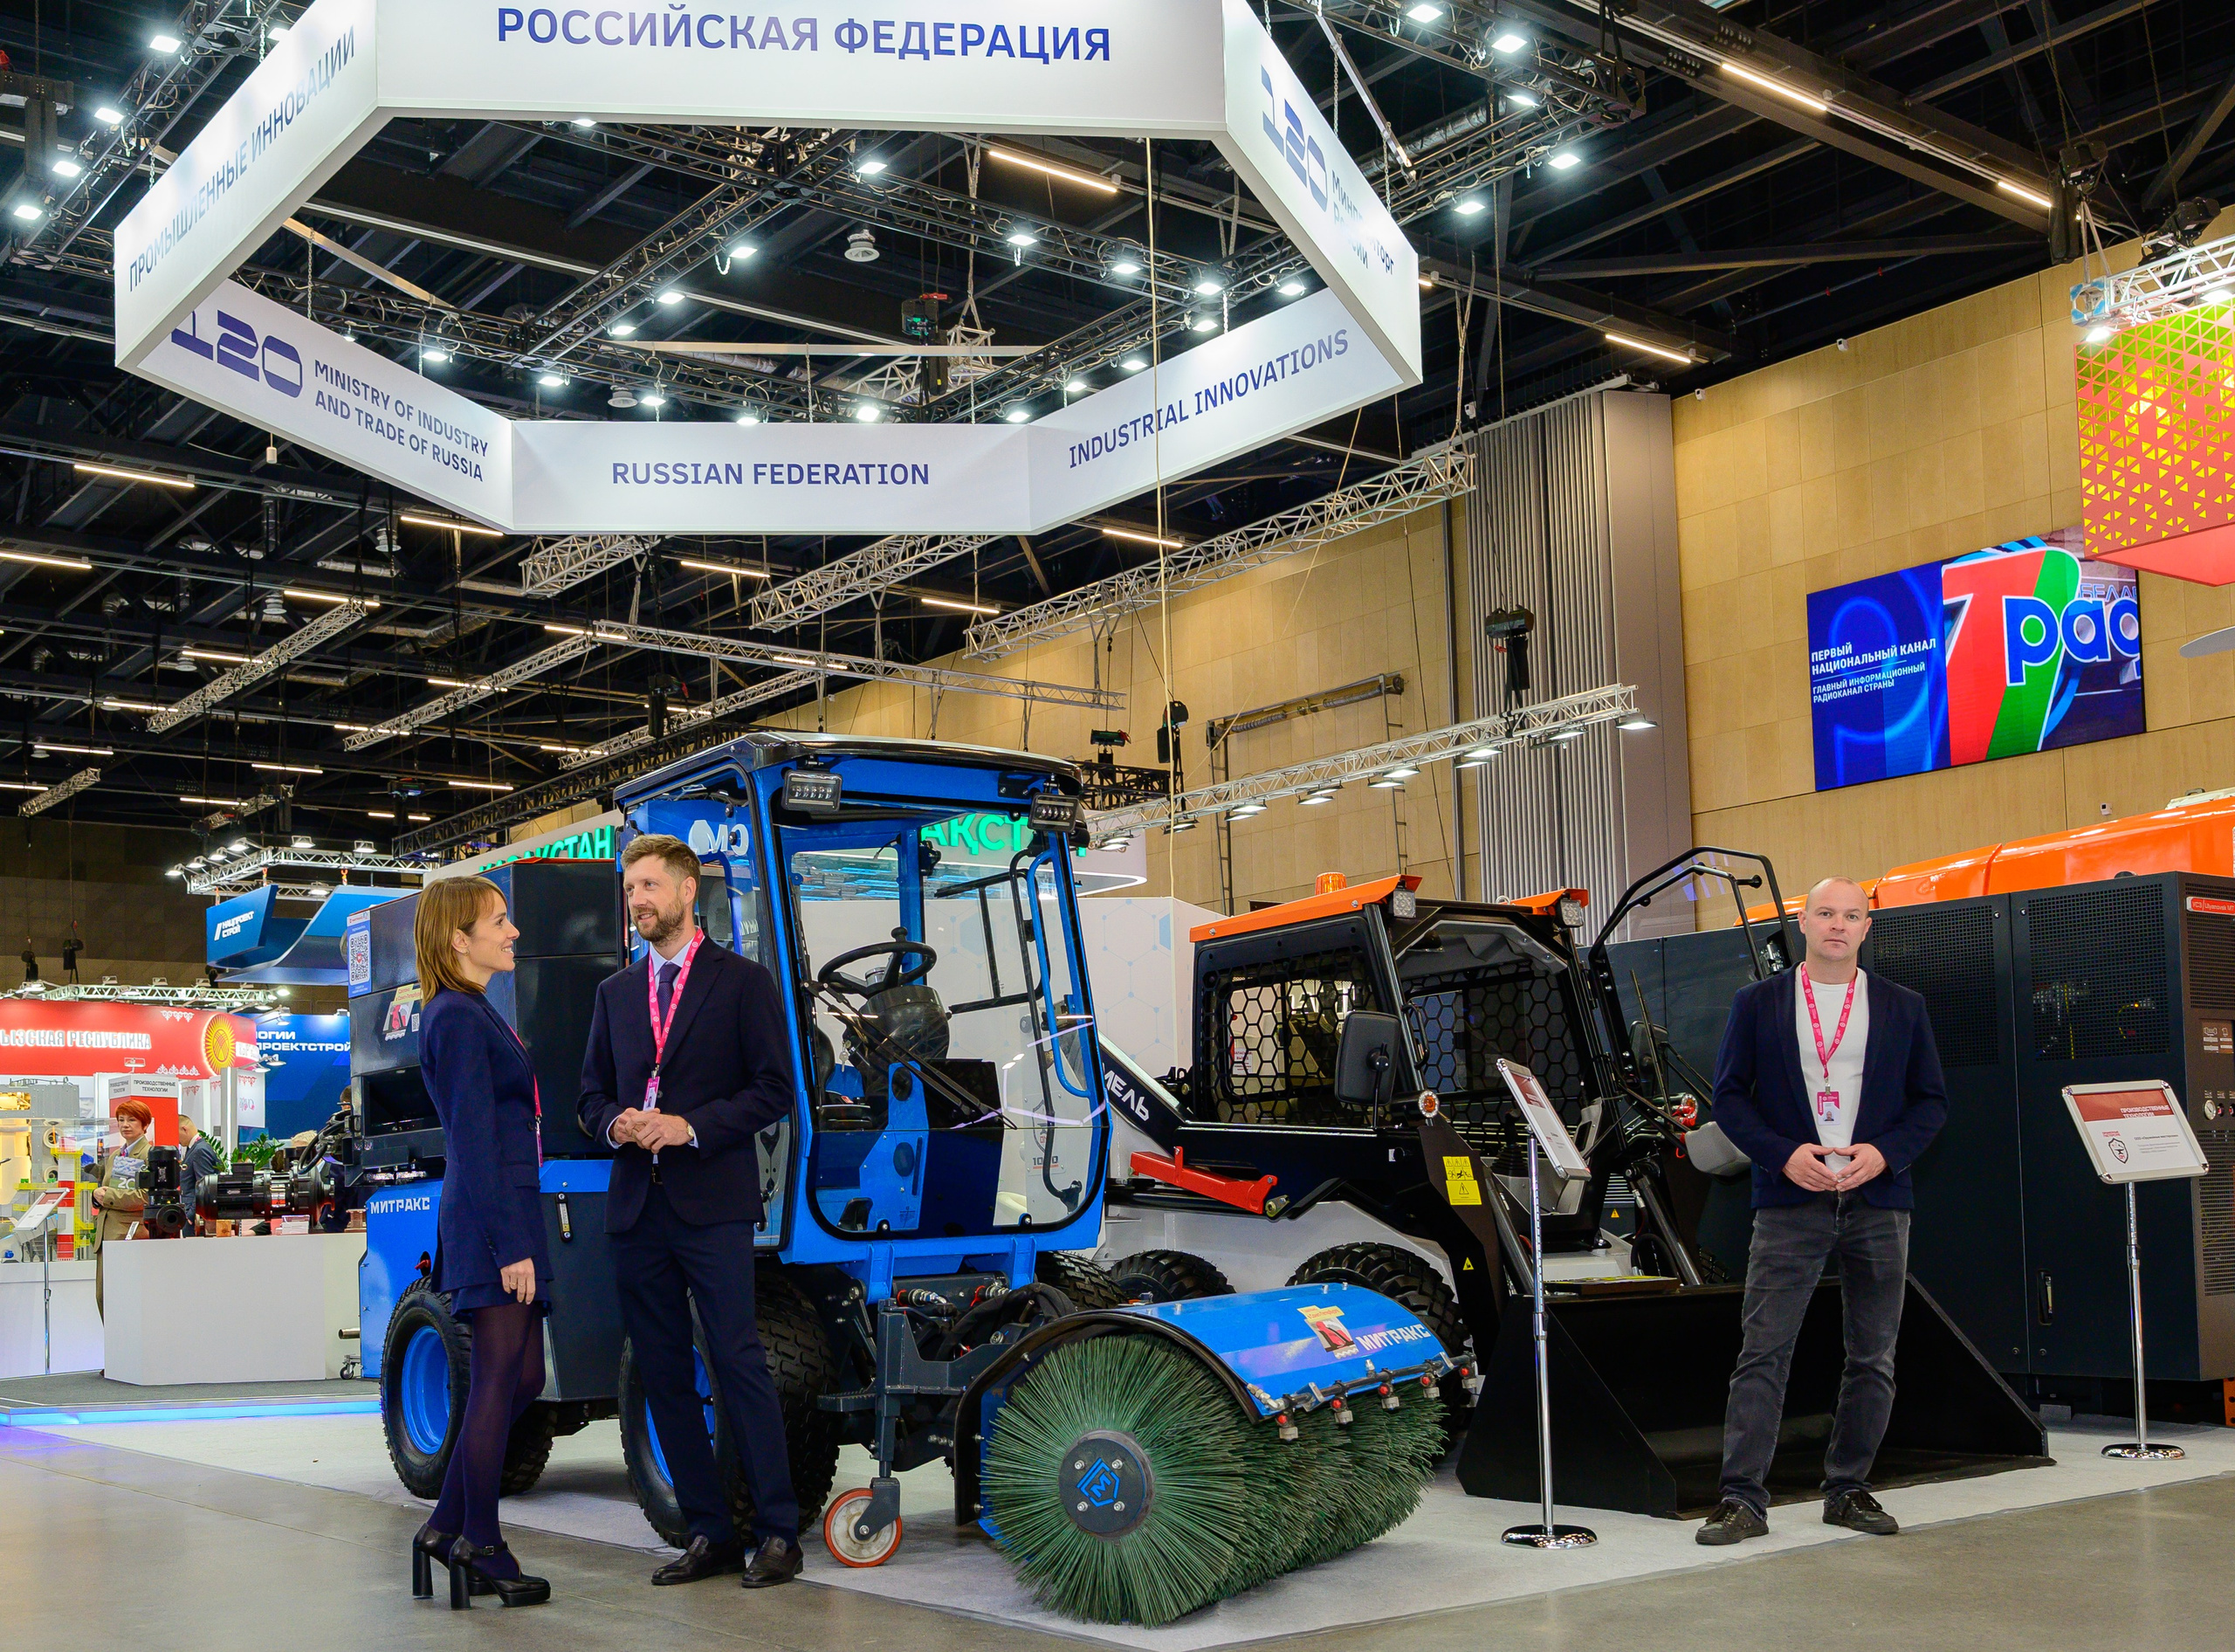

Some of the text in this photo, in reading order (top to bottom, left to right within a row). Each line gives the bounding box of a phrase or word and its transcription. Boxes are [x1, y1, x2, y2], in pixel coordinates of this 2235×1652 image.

[497, 3, 1111, 65] РОССИЙСКАЯ ФЕДЕРАЦИЯ
[129, 24, 355, 293] ПРОМЫШЛЕННЫЕ ИННОВАЦИИ
[1331, 169, 1394, 275] Минпторг
[314, 359, 489, 458] MINISTRY OF INDUSTRY
[1069, 328, 1350, 469] INDUSTRIAL INNOVATIONS
[314, 389, 484, 483] AND TRADE OF RUSSIA
[612, 463, 930, 486] RUSSIAN FEDERATION
[1811, 641, 1853, 663] ПЕРВЫЙ
[1812, 637, 1936, 676] НАЦИОНАЛЬНЫЙ КАНАЛ
[1812, 661, 1926, 695] ГЛАВНЫЙ ИНФОРМАЦИОННЫЙ
[1813, 678, 1895, 704] РАДИОКАНАЛ СТРАНЫ
[66, 1030, 152, 1050] РЕСПУБЛИКА
[256, 1030, 296, 1041] ОГИИ
[1032, 1155, 1059, 1166] 100
[369, 1196, 430, 1215] МИТРАКС
[1355, 1323, 1432, 1352] МИТРАКС
